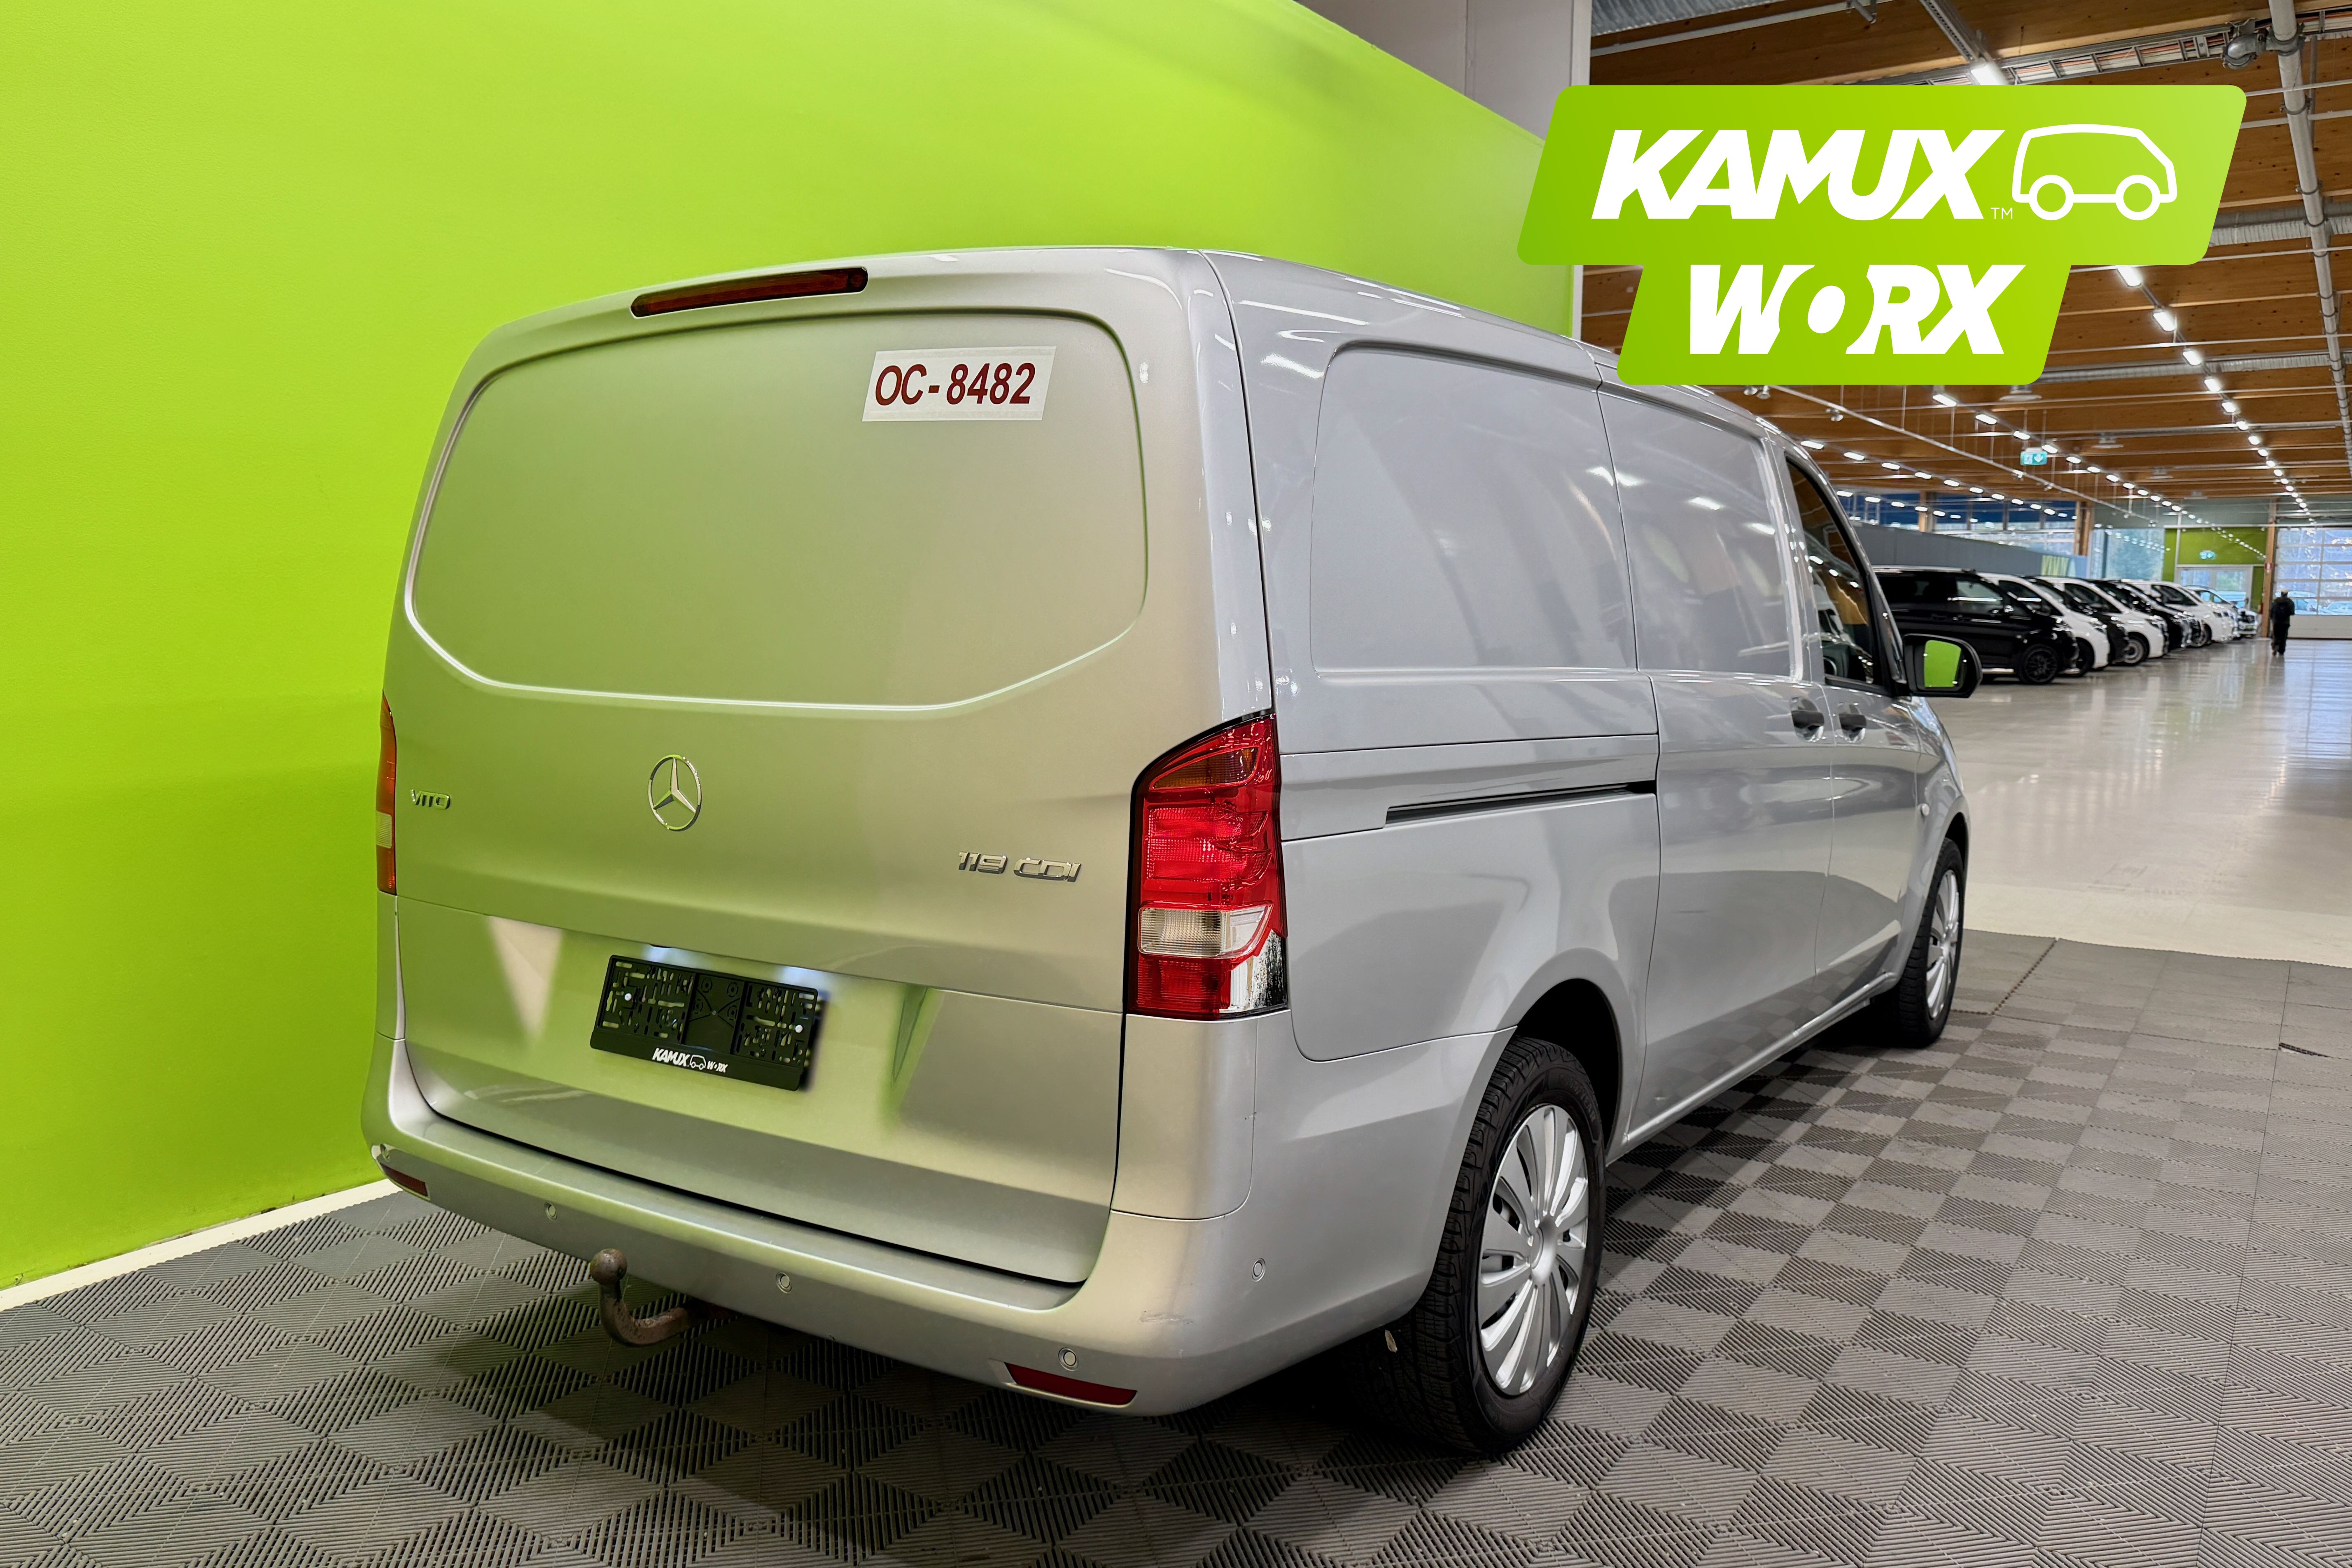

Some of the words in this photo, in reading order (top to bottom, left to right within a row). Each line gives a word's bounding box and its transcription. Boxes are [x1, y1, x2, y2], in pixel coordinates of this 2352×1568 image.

[411, 789, 451, 810] VITO
[958, 851, 1008, 875] 119
[1013, 857, 1082, 882] CDI
[652, 1048, 691, 1067] KAMUX
